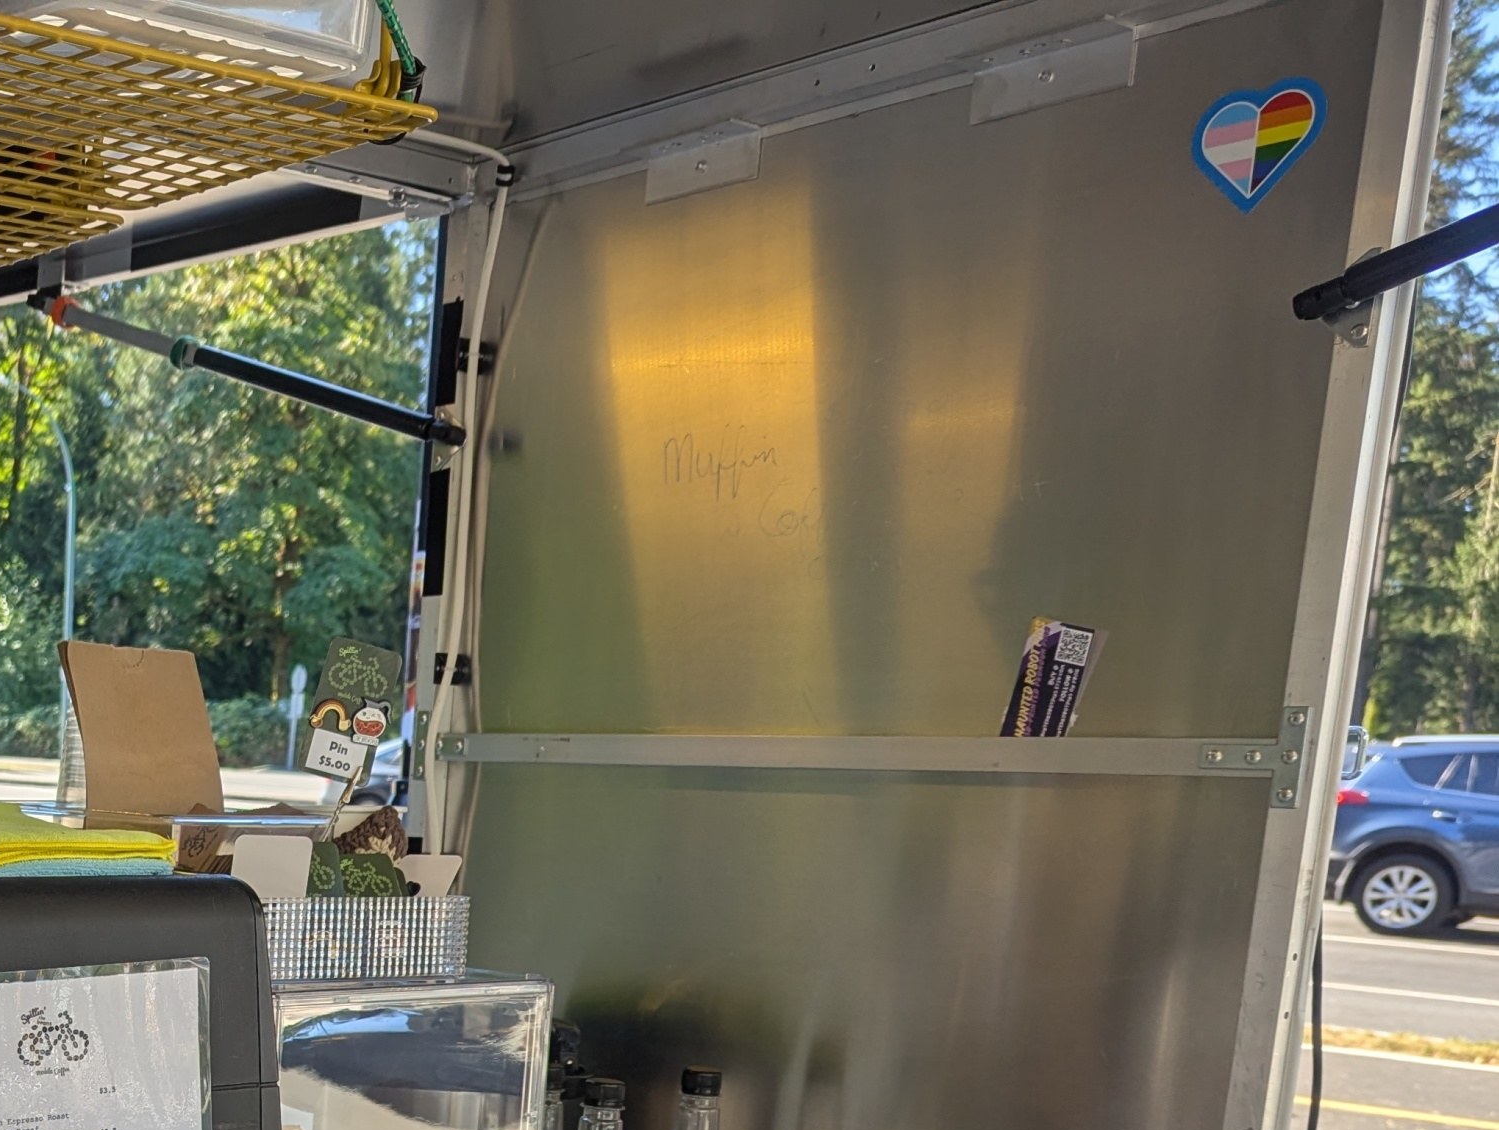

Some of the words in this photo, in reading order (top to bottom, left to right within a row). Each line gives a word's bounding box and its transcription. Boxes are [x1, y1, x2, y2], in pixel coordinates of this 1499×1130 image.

[664, 424, 778, 501] Muffin
[1014, 686, 1033, 737] HAUNTED
[1024, 647, 1041, 686] ROBOT
[329, 741, 349, 755] Pin
[319, 755, 351, 771] $5.00
[100, 1086, 116, 1094] $3.5
[7, 1116, 44, 1126] Espresso
[47, 1113, 70, 1121] Roast
